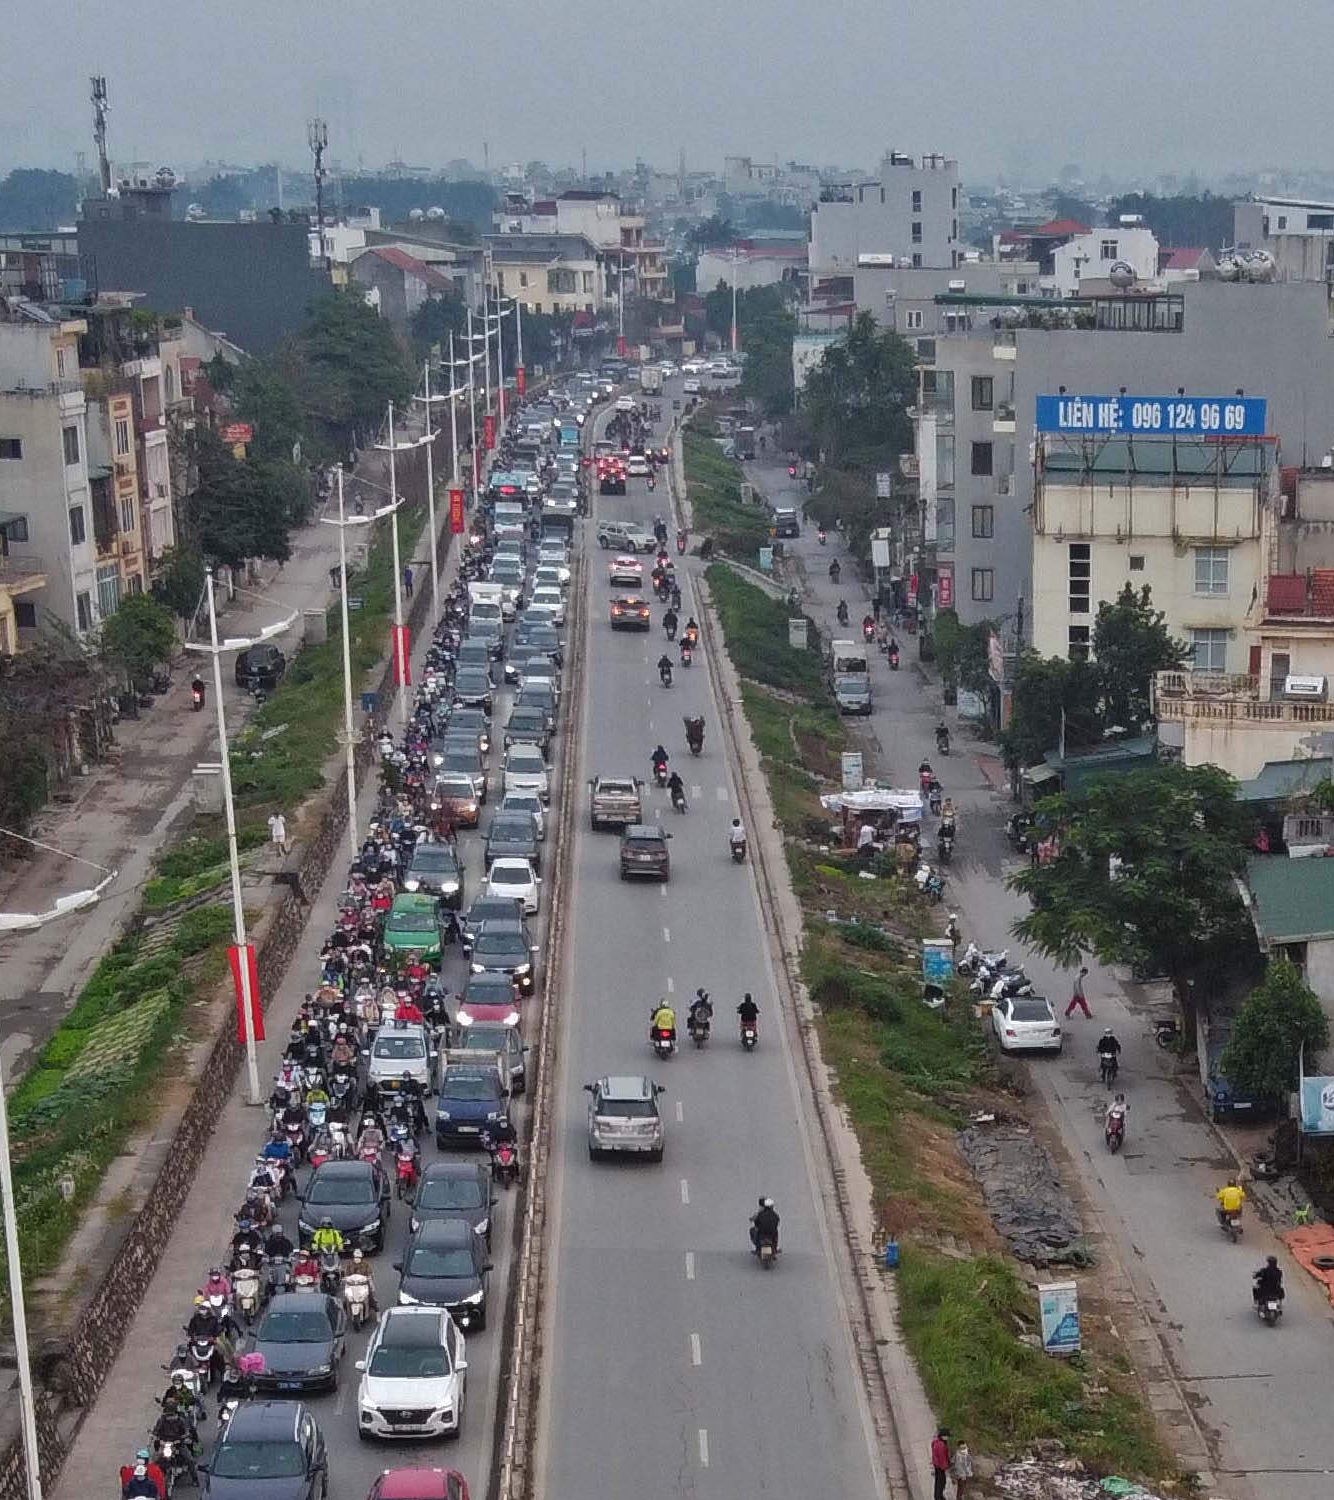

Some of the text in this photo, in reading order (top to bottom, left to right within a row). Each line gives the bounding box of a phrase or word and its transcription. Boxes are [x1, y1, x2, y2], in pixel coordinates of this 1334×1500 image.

[1058, 397, 1094, 428] LIÊN
[1132, 402, 1162, 429] 096
[1167, 403, 1195, 429] 124
[1201, 403, 1220, 430] 96
[1224, 403, 1245, 430] 69
